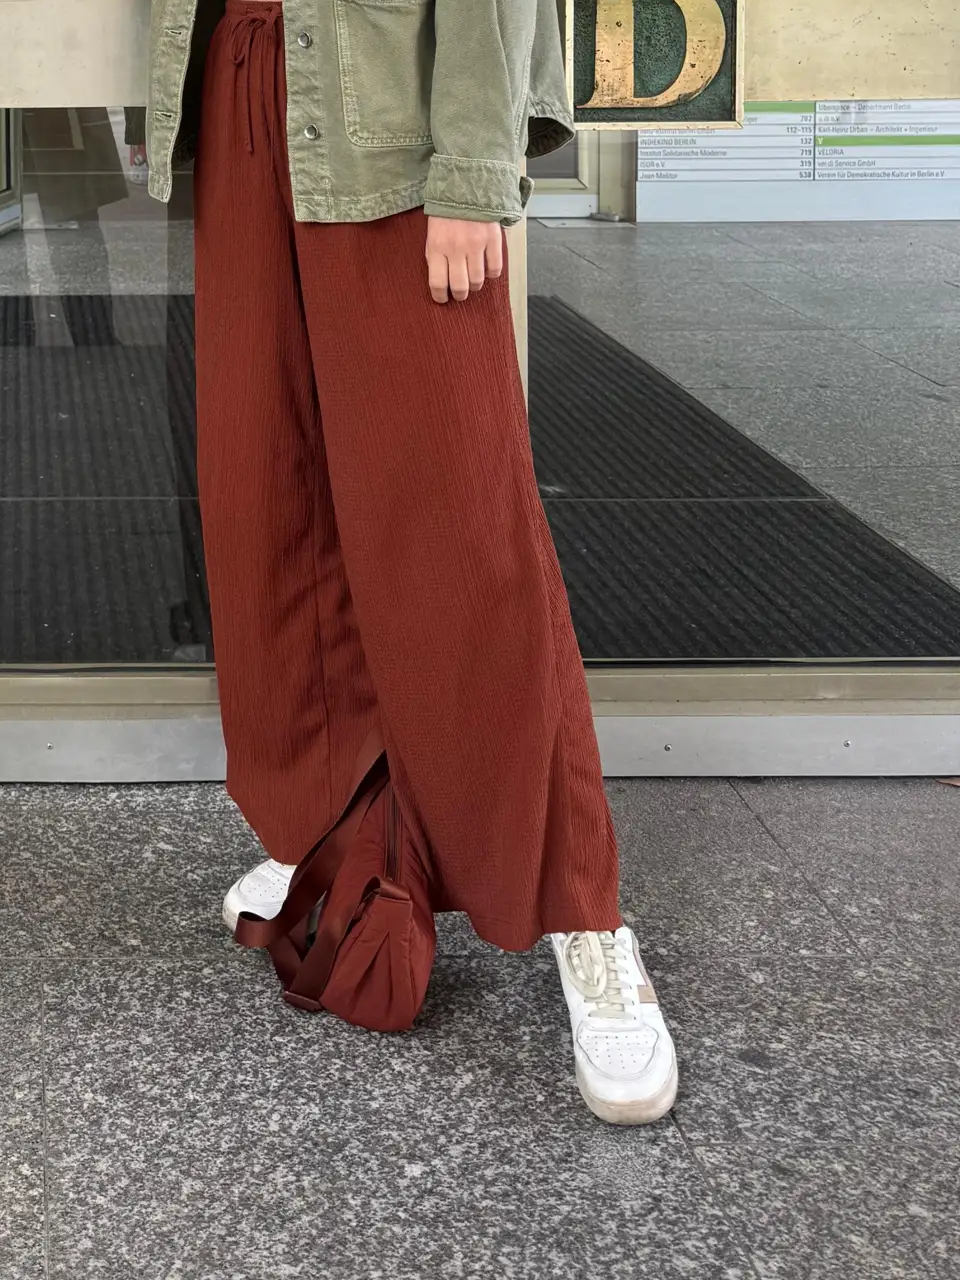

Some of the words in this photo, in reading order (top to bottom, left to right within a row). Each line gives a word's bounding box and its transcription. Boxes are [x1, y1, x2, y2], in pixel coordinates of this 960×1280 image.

[674, 138, 696, 146] BERLIN
[800, 160, 812, 168] 319
[892, 170, 909, 178] Kultur
[910, 170, 916, 178] in
[916, 170, 934, 178] Berlin
